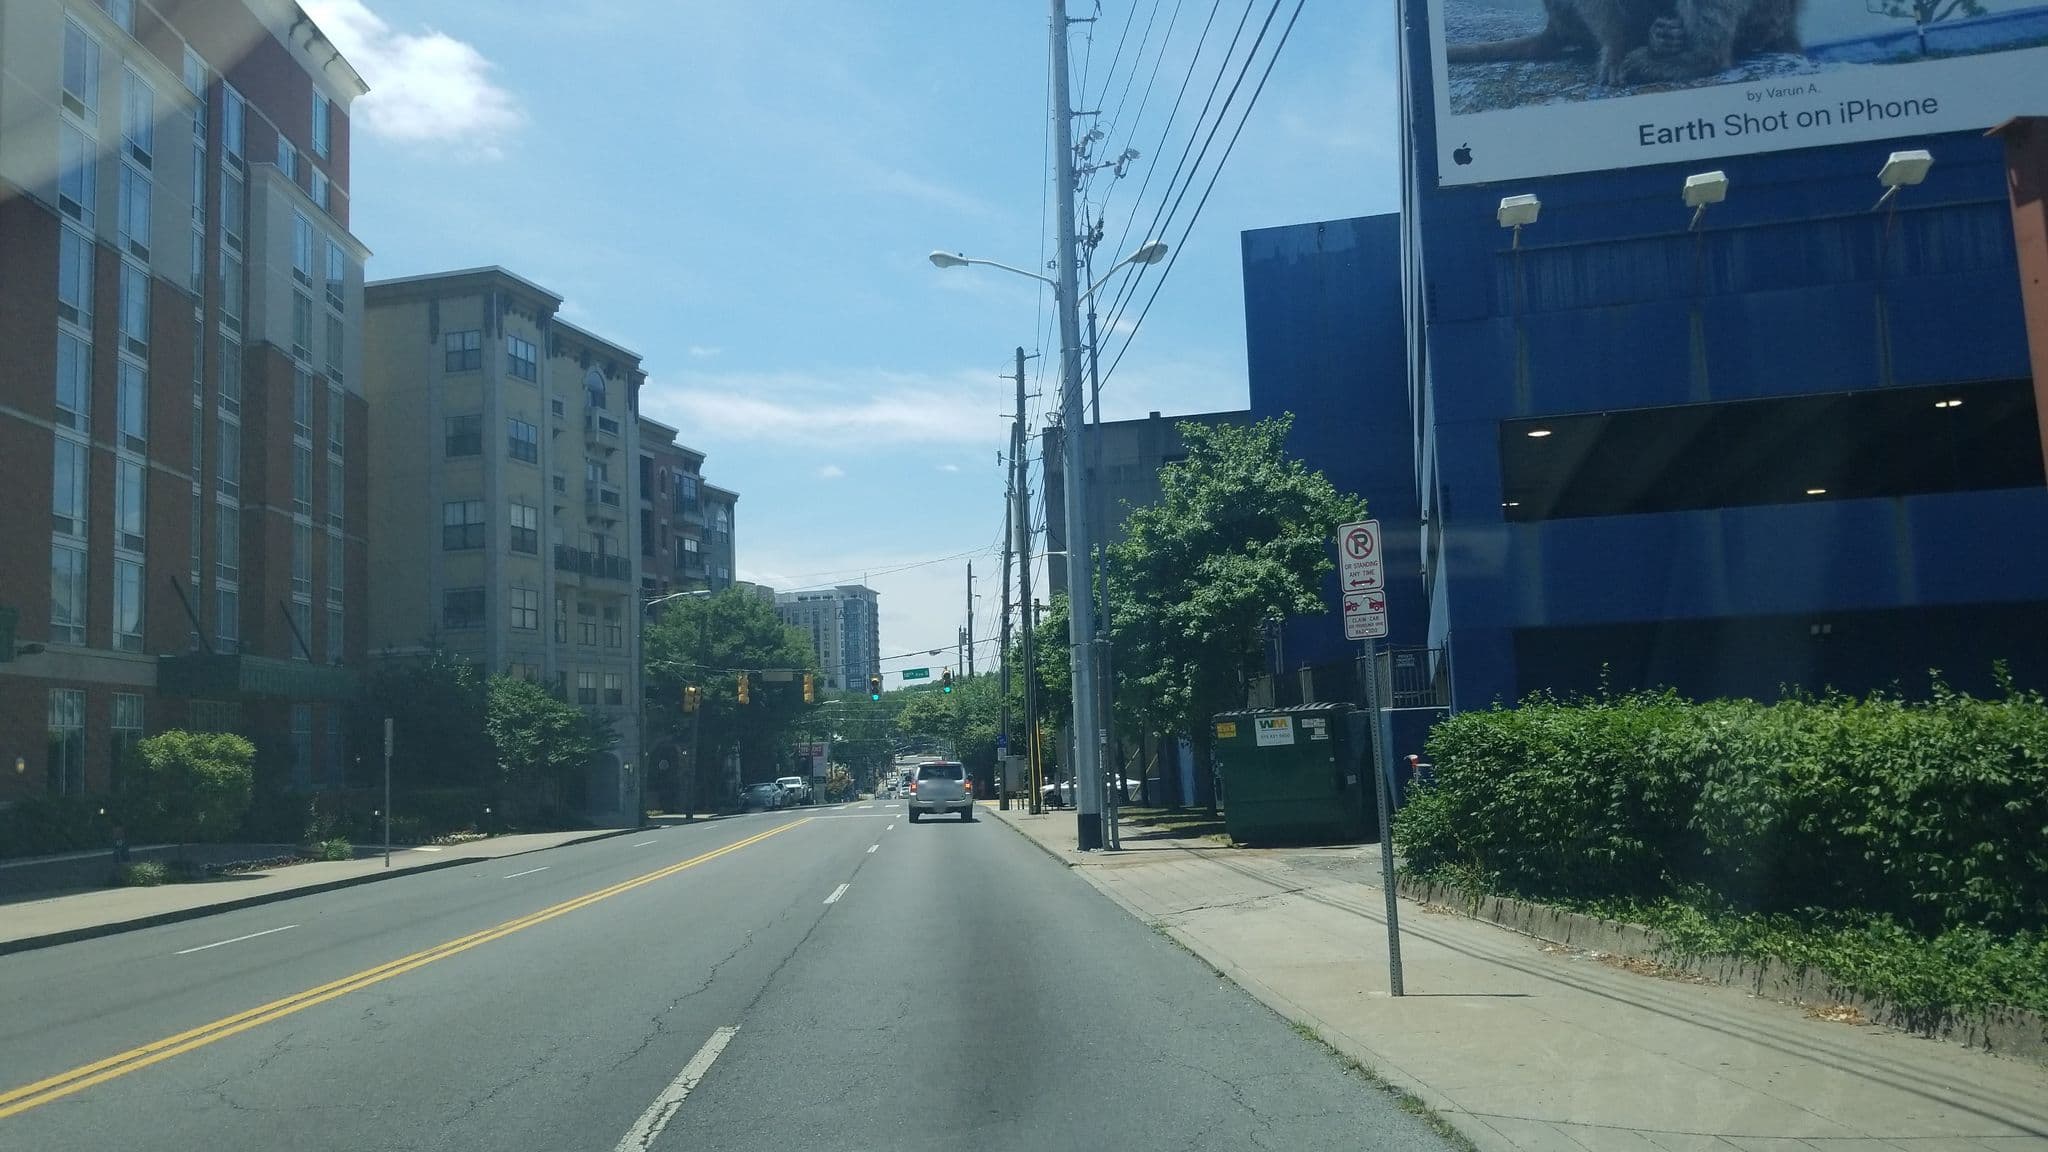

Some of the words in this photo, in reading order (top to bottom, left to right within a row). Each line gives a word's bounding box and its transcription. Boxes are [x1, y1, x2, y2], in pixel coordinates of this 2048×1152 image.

[1746, 88, 1763, 103] by
[1765, 85, 1804, 100] Varun
[1807, 83, 1821, 97] A.
[1638, 118, 1716, 147] Earth
[1723, 109, 1788, 138] Shot
[1796, 106, 1833, 129] on
[1840, 94, 1939, 125] iPhone
[1353, 560, 1379, 570] STANDING
[1349, 570, 1362, 578] ANY
[1363, 568, 1376, 577] TIME
